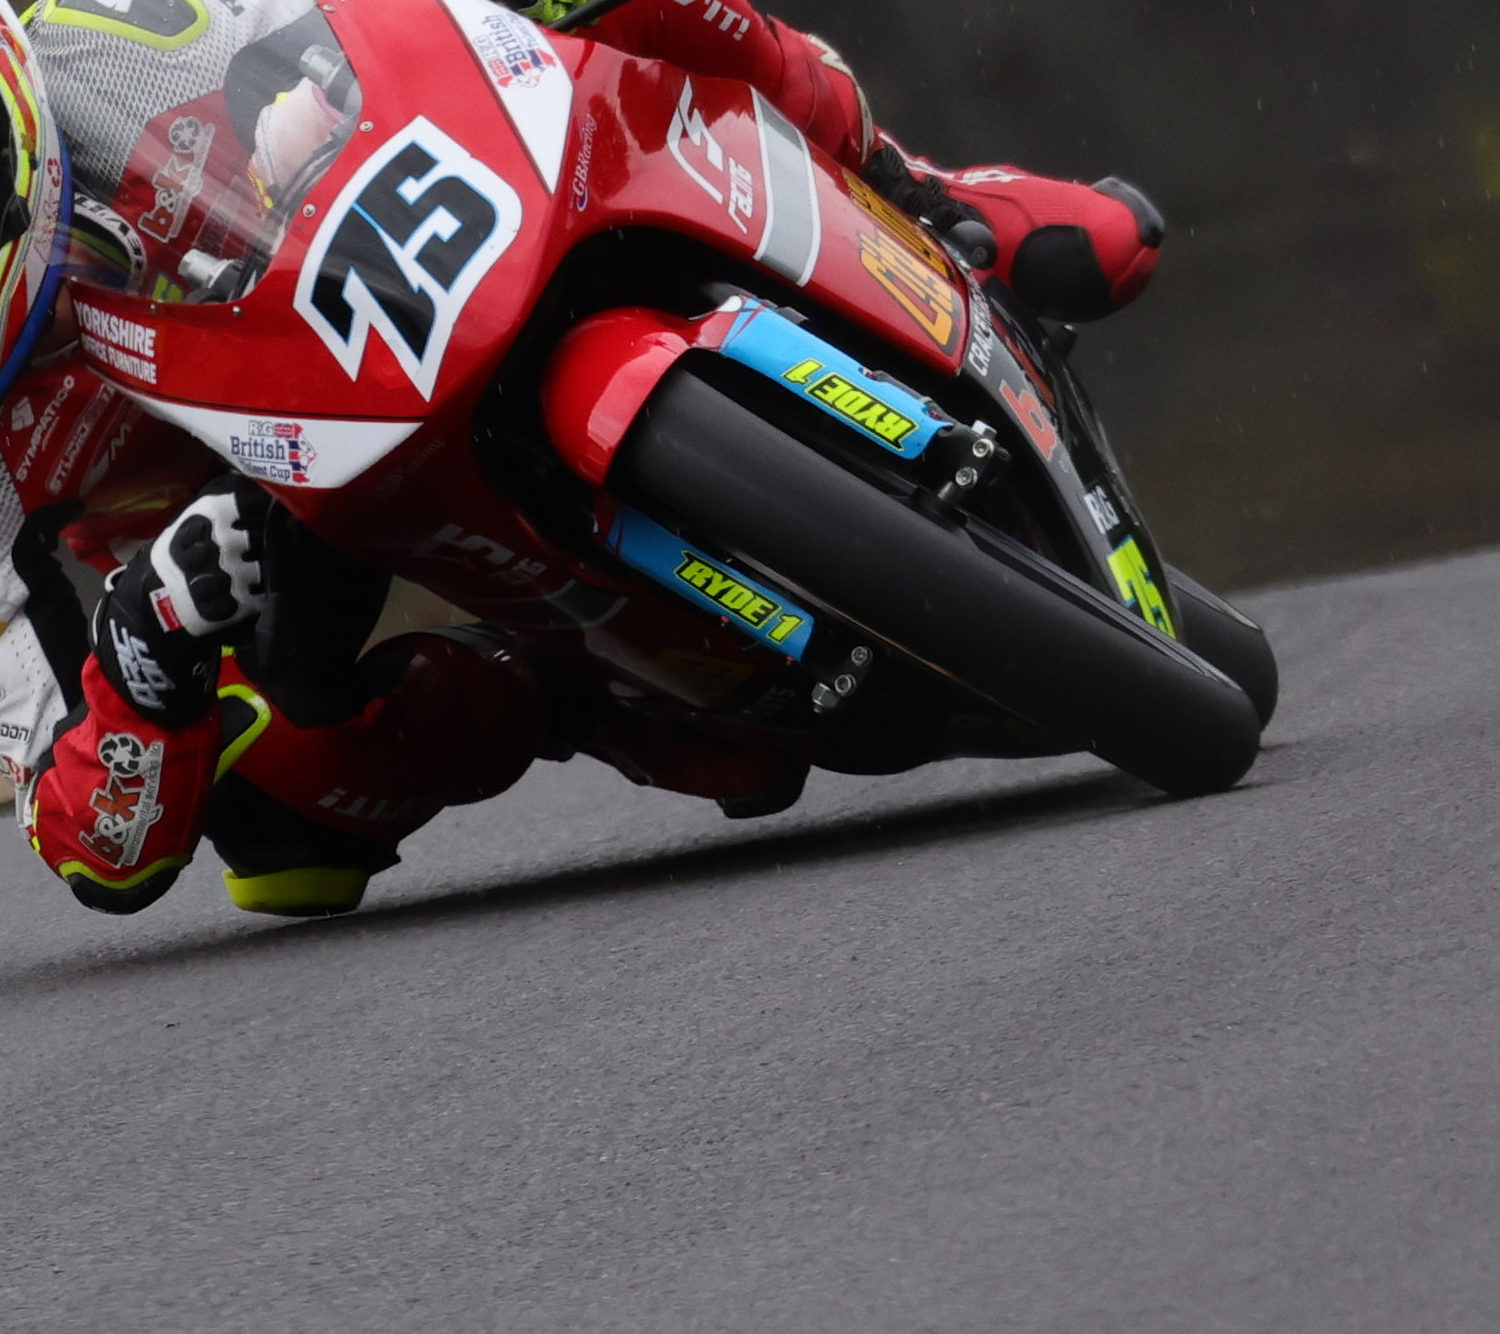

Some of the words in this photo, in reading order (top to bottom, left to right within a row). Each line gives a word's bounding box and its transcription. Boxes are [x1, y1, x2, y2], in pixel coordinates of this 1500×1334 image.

[482, 12, 525, 66] British
[572, 113, 597, 199] GBRacing
[728, 156, 754, 235] racing
[311, 139, 499, 367] 75
[73, 299, 157, 359] YORKSHIRE
[81, 333, 108, 365] OFFICE
[108, 347, 157, 386] FURNITURE
[784, 359, 823, 386] 1
[16, 374, 75, 483] SYMPATICO
[230, 434, 287, 461] British
[812, 376, 914, 448] RYDE
[269, 464, 291, 482] Cup
[680, 559, 776, 627] RYDE
[767, 614, 804, 643] 1
[80, 782, 142, 868] b&k
